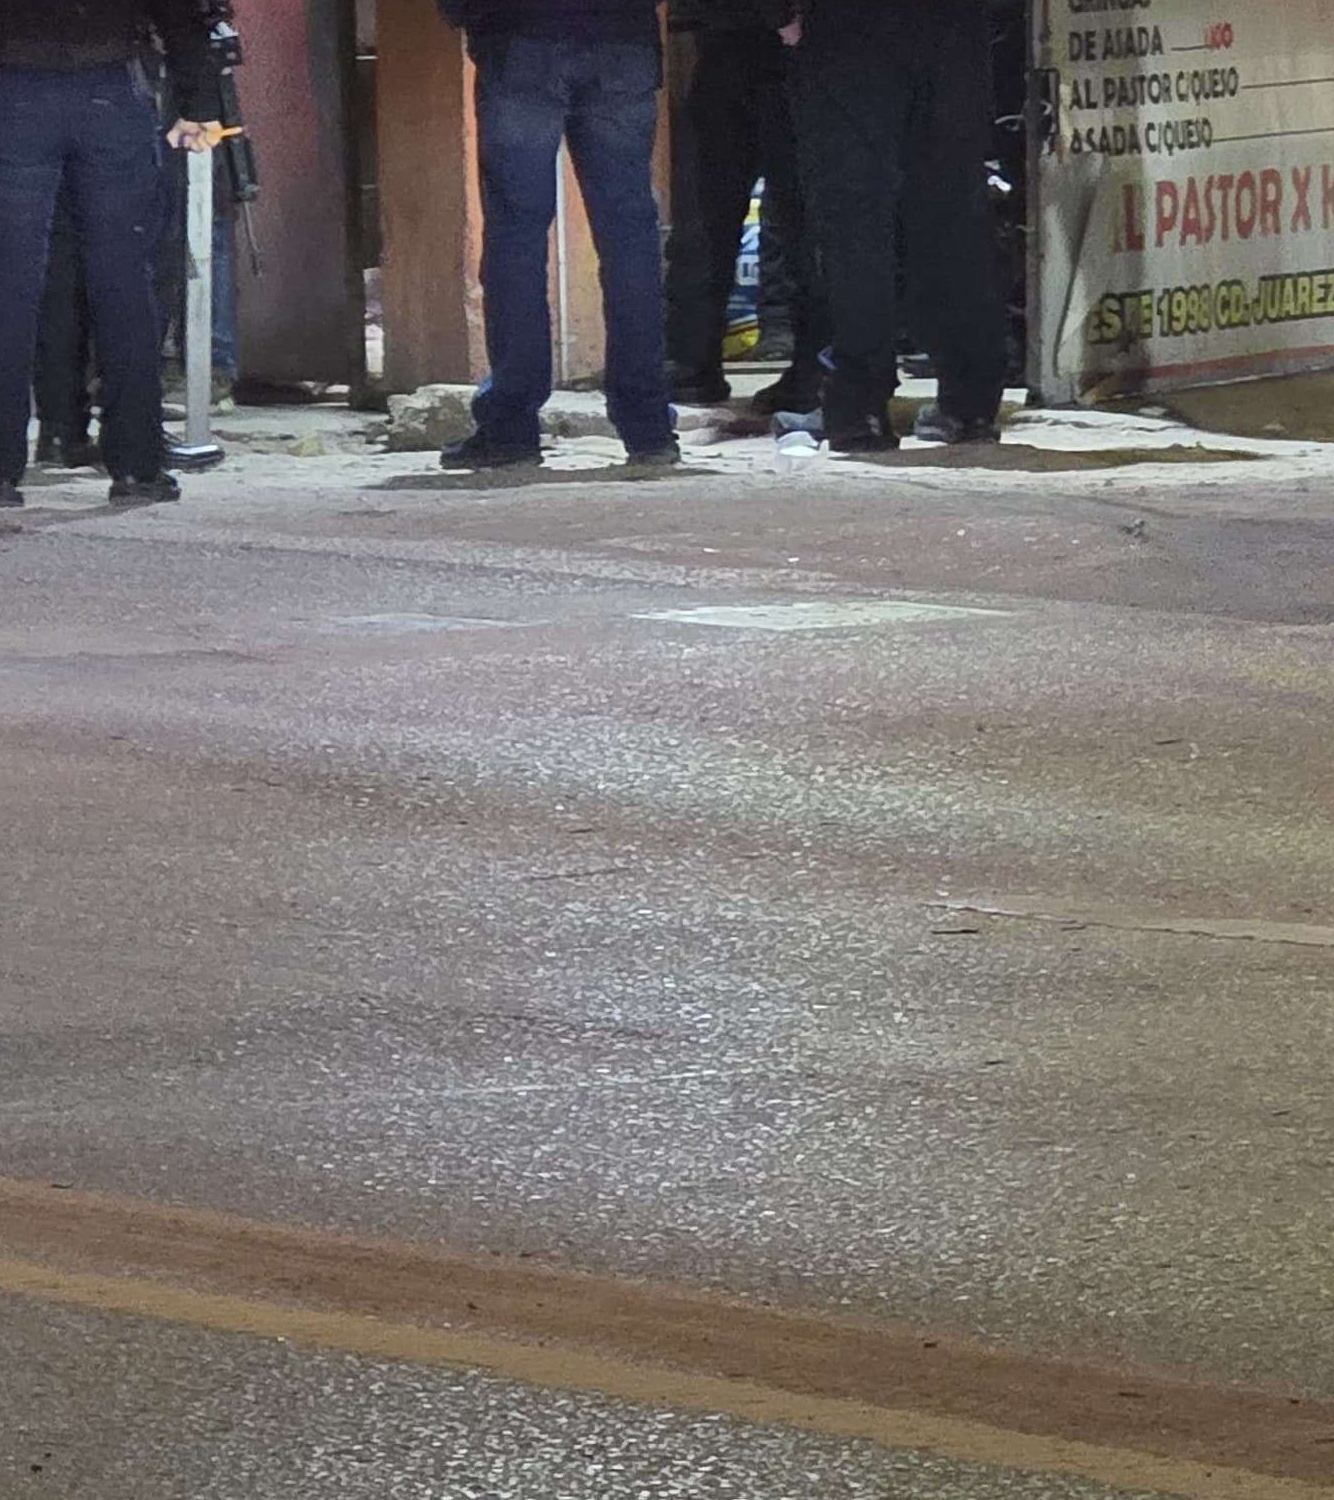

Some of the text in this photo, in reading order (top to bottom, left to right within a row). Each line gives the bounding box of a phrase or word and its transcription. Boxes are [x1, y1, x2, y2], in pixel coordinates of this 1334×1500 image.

[1069, 30, 1097, 62] DE
[1102, 25, 1164, 61] ASADA
[1069, 78, 1097, 110] AL
[1103, 73, 1172, 109] PASTOR
[1070, 123, 1142, 156] ASADA
[1155, 168, 1283, 247] PASTOR
[1289, 164, 1312, 233] X
